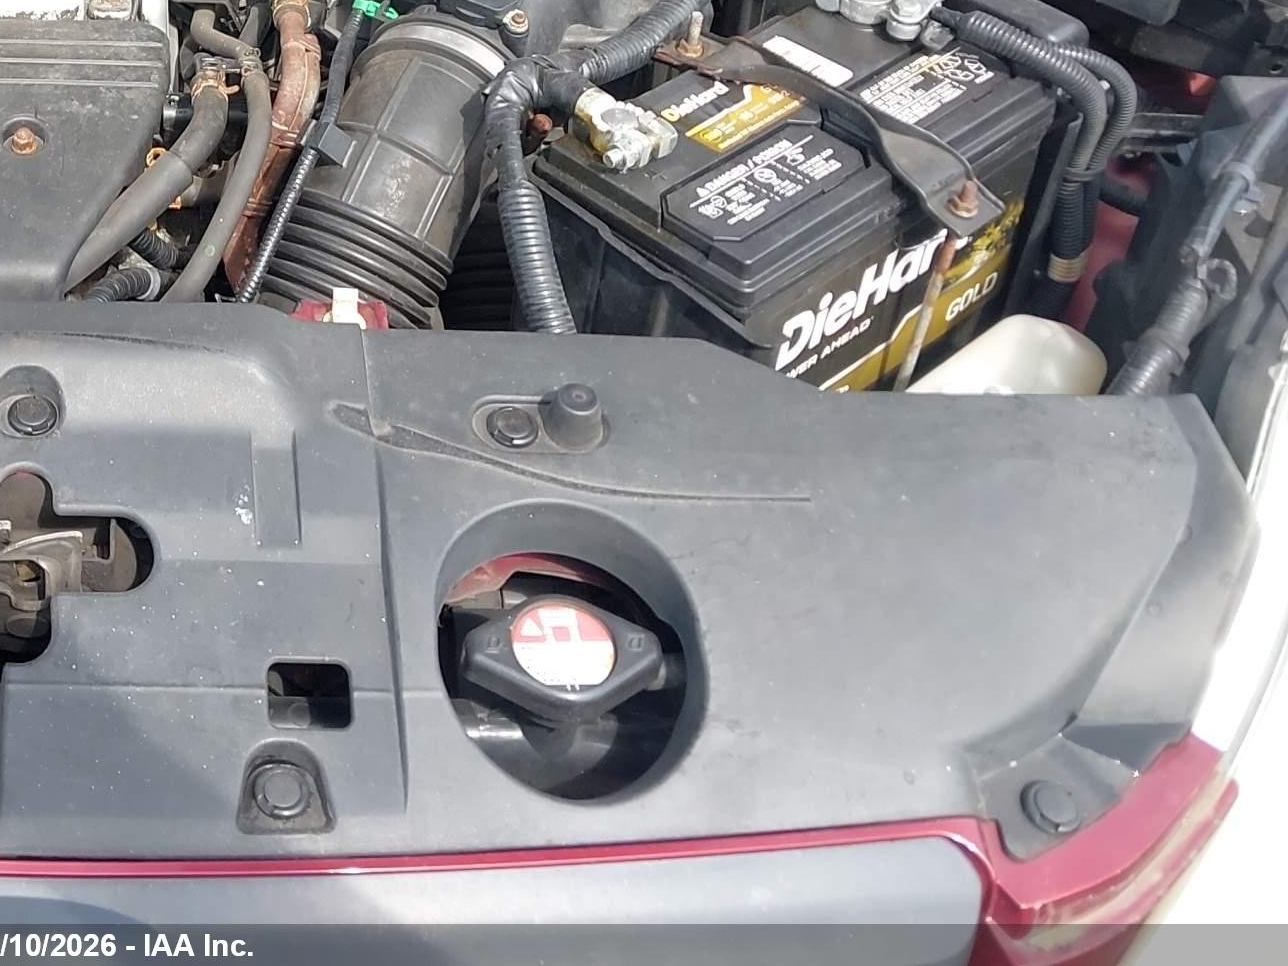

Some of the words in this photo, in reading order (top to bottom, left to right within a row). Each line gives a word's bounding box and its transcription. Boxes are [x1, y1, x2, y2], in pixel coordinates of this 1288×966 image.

[661, 80, 730, 122] DieHard
[775, 228, 968, 371] DieHar
[945, 272, 998, 322] GOLD
[786, 354, 818, 378] WER
[820, 318, 873, 360] AHEAD
